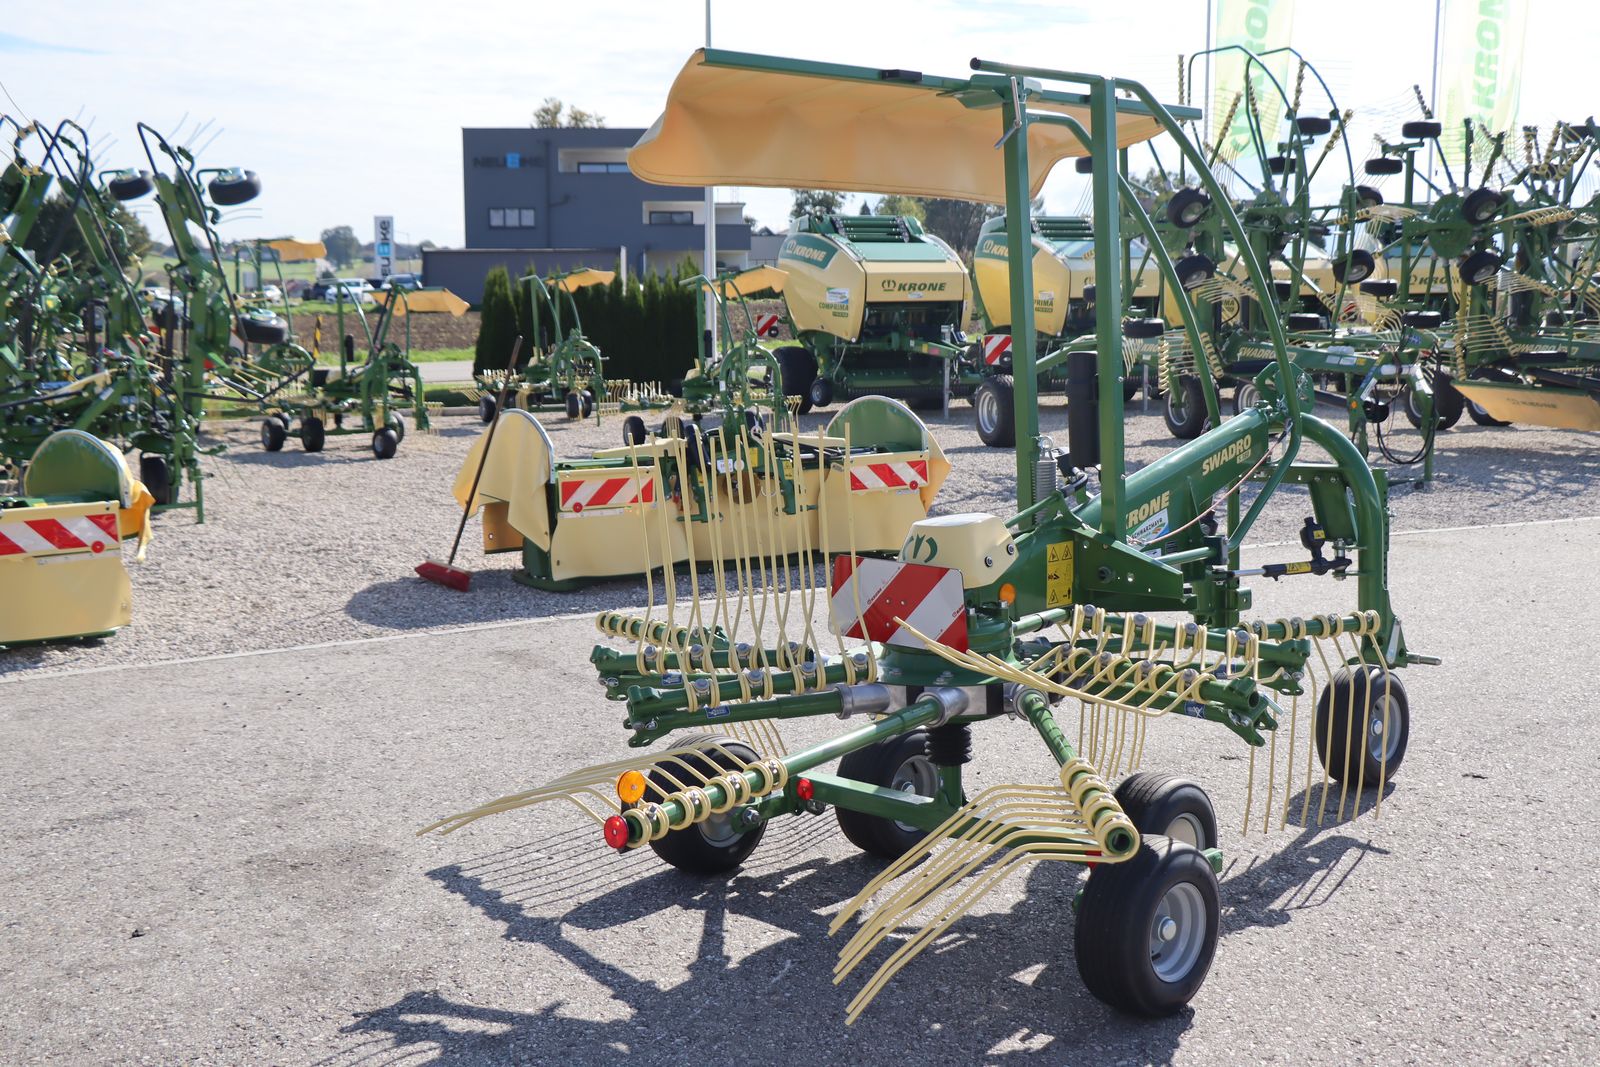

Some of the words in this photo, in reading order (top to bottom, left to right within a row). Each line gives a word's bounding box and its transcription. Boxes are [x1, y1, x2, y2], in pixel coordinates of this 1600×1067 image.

[794, 245, 827, 262] KRONE
[897, 282, 947, 292] KRONE
[819, 302, 849, 311] COMPRIMA
[1202, 433, 1252, 476] SWADRO
[1125, 490, 1170, 530] RONE
